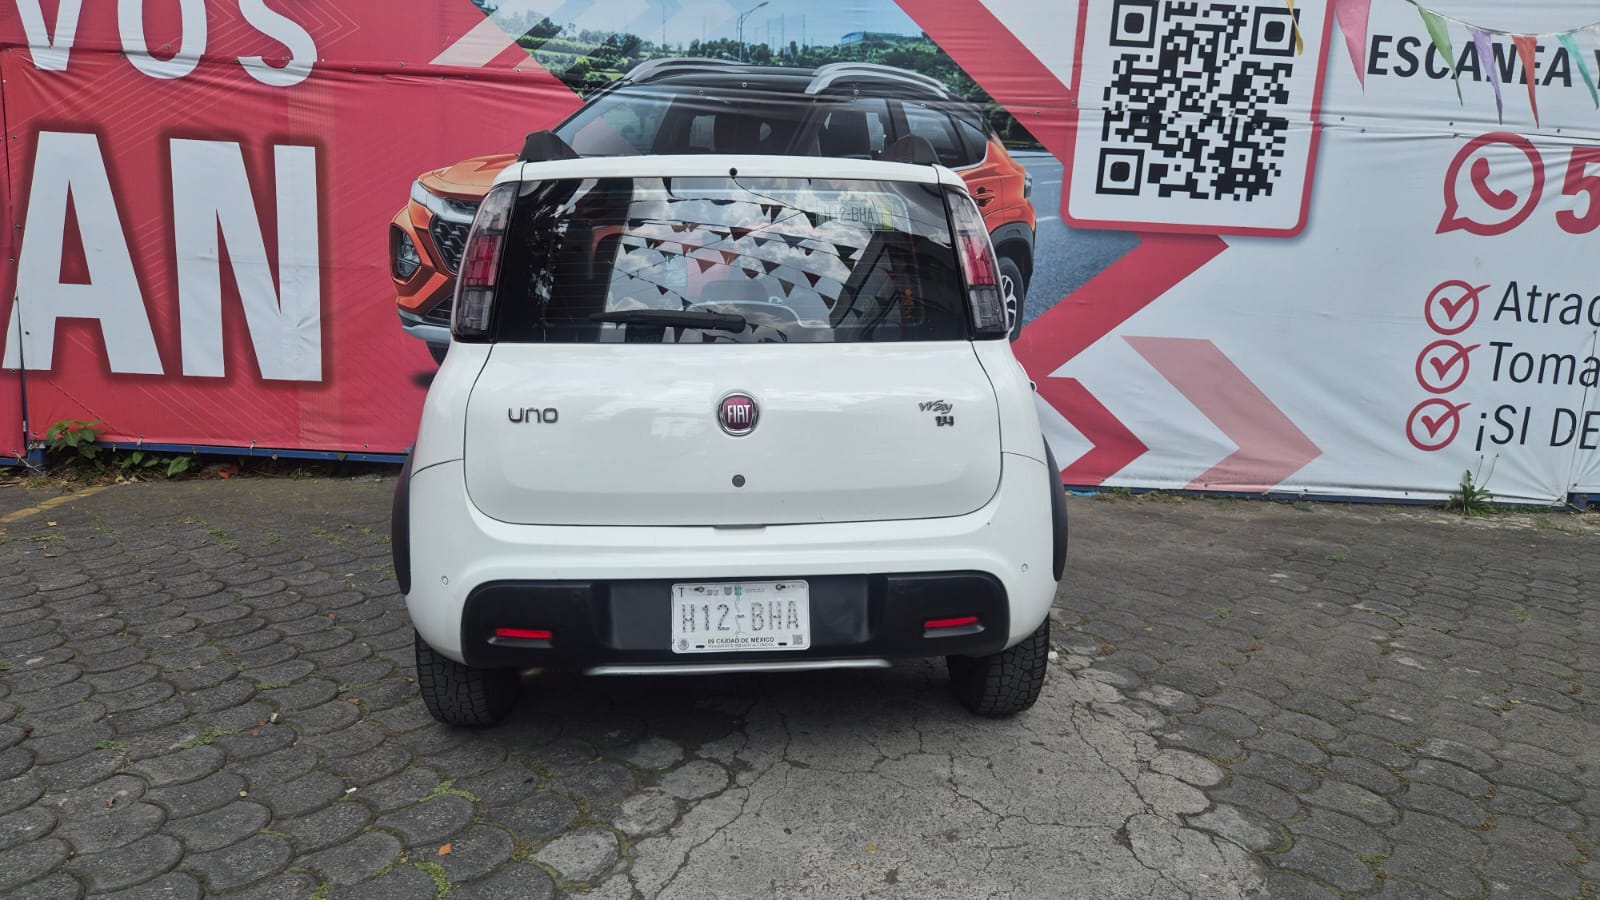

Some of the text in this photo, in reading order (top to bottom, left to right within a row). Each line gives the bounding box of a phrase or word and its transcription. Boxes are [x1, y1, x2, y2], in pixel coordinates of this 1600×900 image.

[1367, 34, 1572, 88] ESCANEA
[824, 206, 874, 223] H2-BHA
[2, 131, 322, 382] AN
[1489, 341, 1600, 388] Toma
[727, 404, 751, 424] FIAT
[1475, 404, 1600, 451] ¡SI DE
[681, 601, 799, 633] H12-BHA
